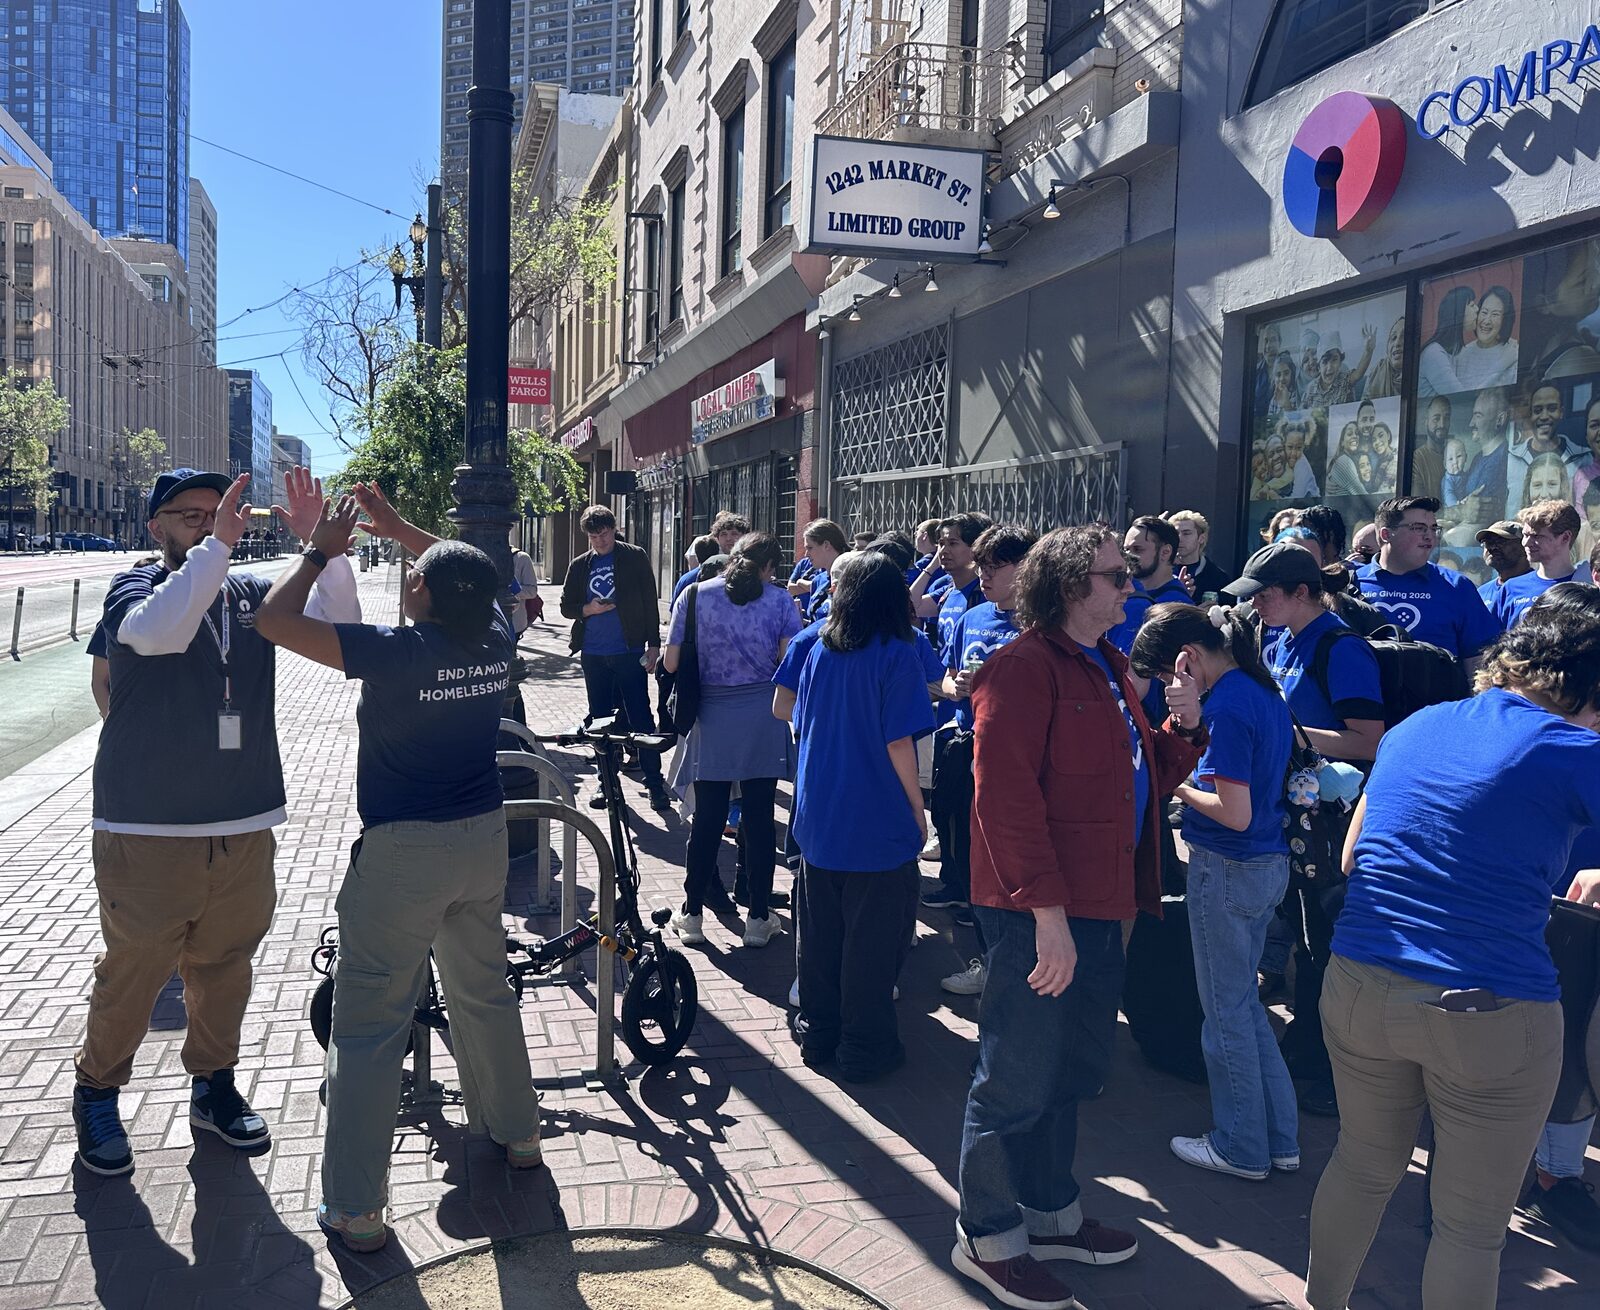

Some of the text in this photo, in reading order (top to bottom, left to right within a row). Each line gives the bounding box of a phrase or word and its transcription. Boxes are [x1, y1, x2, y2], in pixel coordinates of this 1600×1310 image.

[825, 160, 972, 207] 1242 MARKET ST.
[827, 211, 965, 240] LIMITED GROUP
[509, 375, 547, 386] WELLS
[510, 386, 547, 397] FARGO
[696, 389, 722, 422] LOCAL
[725, 371, 756, 409] DINER
[1379, 590, 1407, 600] Giving
[1409, 592, 1432, 600] 2026
[980, 628, 1004, 640] Giving
[1004, 630, 1020, 640] 202
[437, 661, 509, 682] END FAMILY
